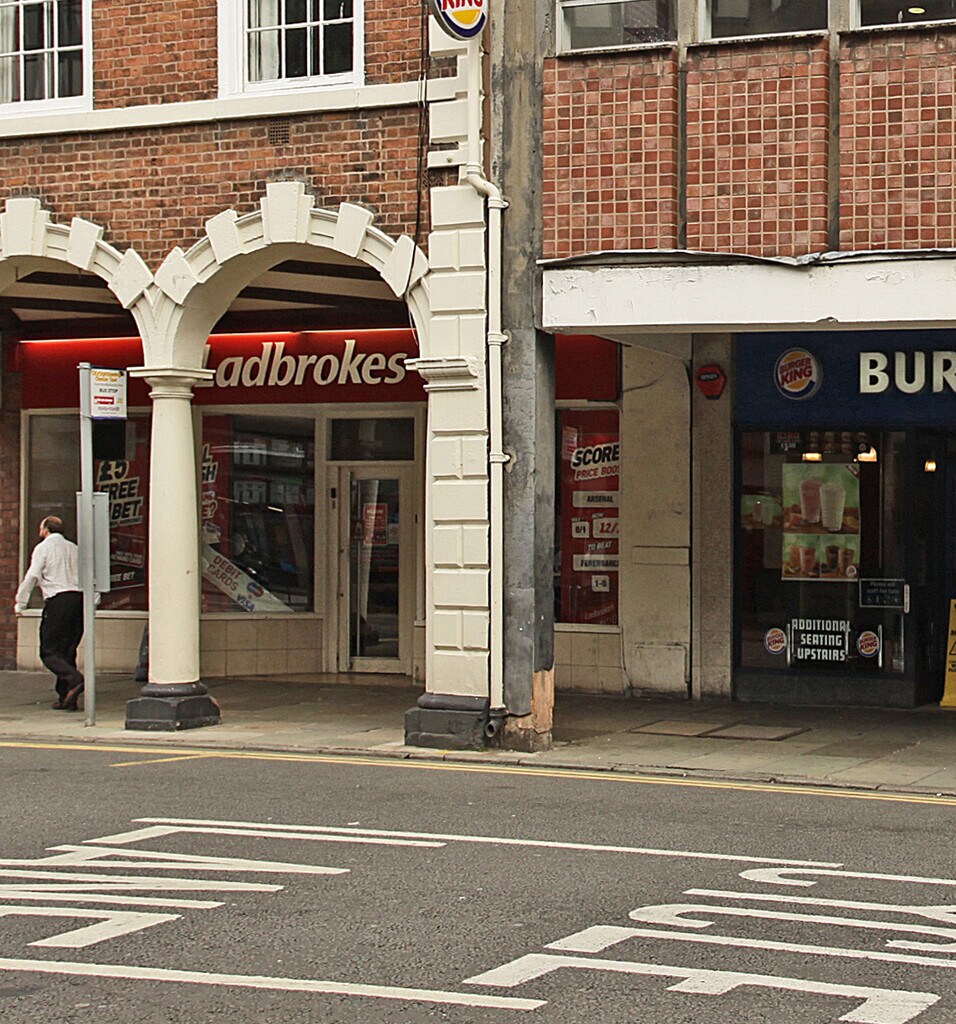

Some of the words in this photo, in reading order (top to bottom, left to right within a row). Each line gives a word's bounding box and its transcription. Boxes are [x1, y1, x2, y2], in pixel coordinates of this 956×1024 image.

[194, 339, 408, 387] Ladbrokes
[779, 357, 812, 374] BURGER
[780, 366, 812, 387] KING
[99, 461, 128, 482] £5
[576, 467, 599, 479] PRICE
[587, 495, 613, 503] ARSENAL
[597, 541, 612, 550] BEAT
[213, 554, 243, 578] DEBIT
[206, 563, 239, 591] CARDS
[237, 593, 256, 612] VISA
[791, 618, 851, 632] ADDITIONAL
[768, 637, 785, 646] KING
[800, 633, 842, 646] SEATING
[860, 640, 878, 650] KING
[797, 647, 846, 661] UPSTAIRS
